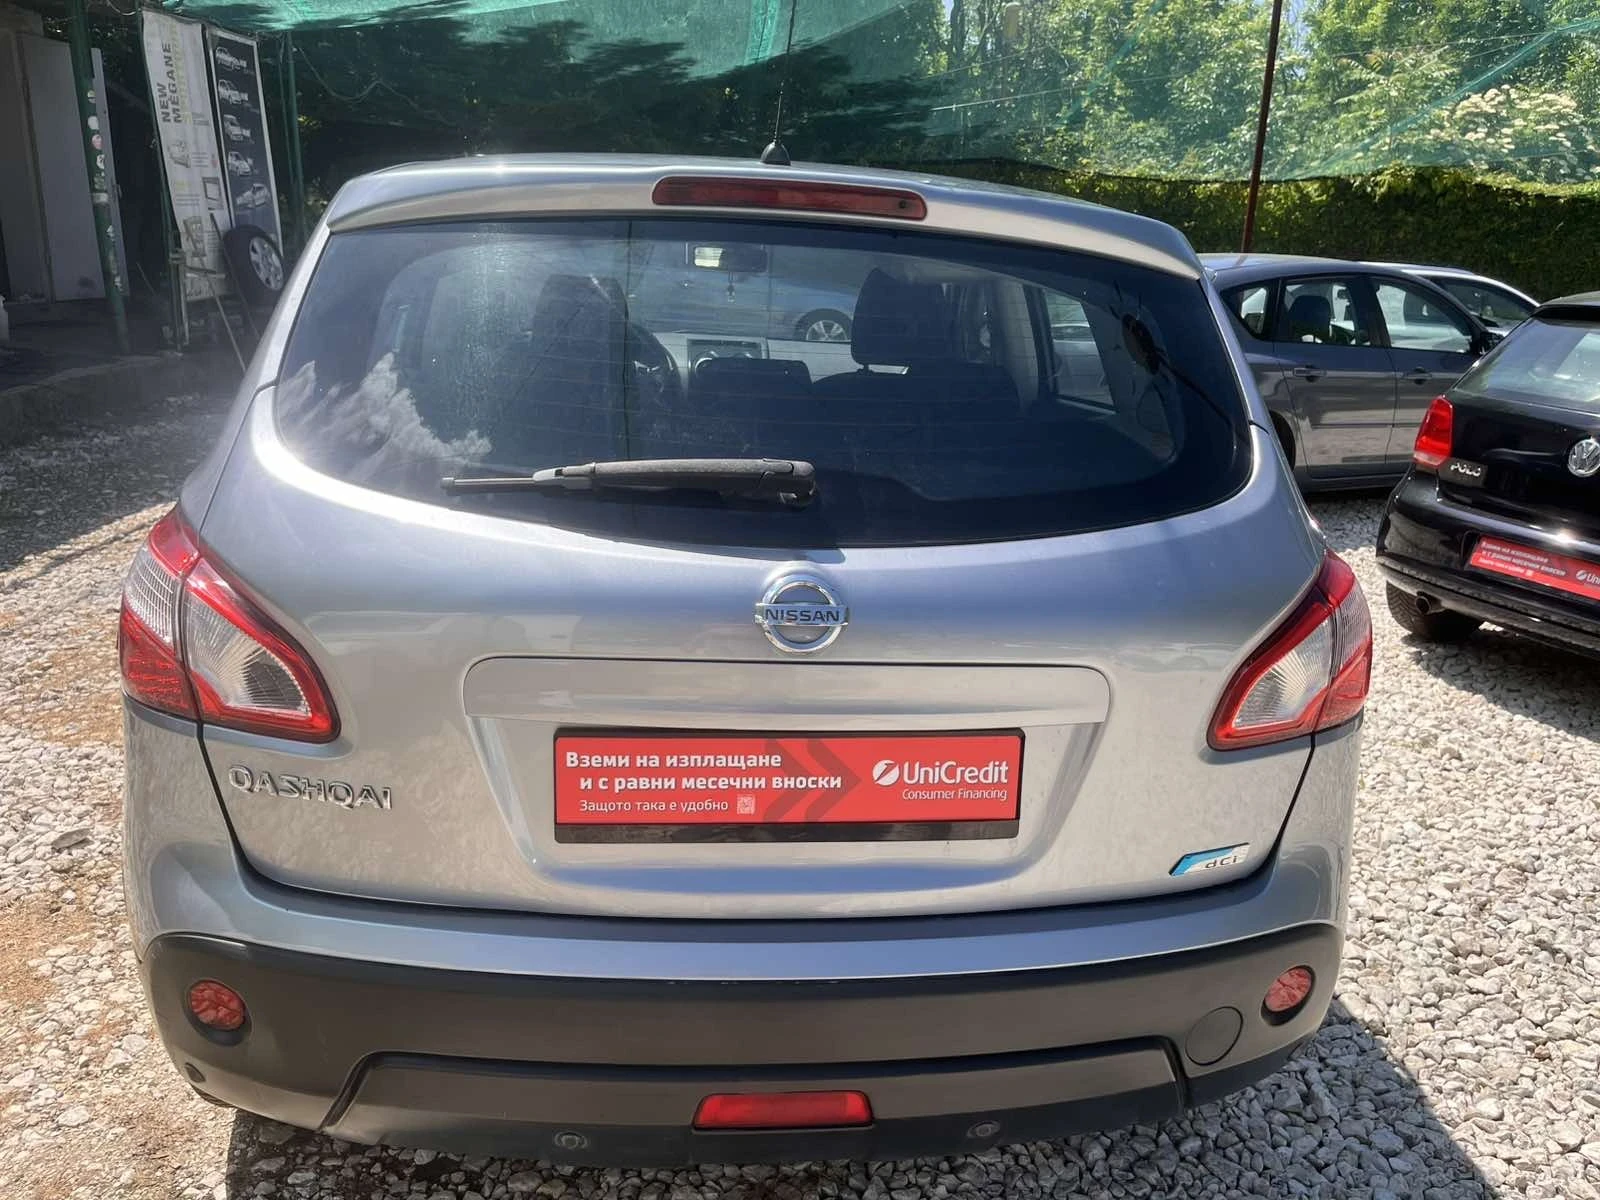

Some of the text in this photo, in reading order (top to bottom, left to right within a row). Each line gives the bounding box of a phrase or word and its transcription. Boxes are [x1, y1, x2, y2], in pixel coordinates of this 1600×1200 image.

[157, 82, 171, 123] NEW
[765, 608, 840, 622] NISSAN
[565, 751, 782, 770] Вземи на изплащане
[903, 760, 1008, 784] UniCredit
[228, 764, 392, 810] QASHQAI
[579, 776, 842, 793] и с равни месечни вноски
[902, 787, 1007, 801] Consumer Financing
[579, 799, 729, 813] Защото така е удобно
